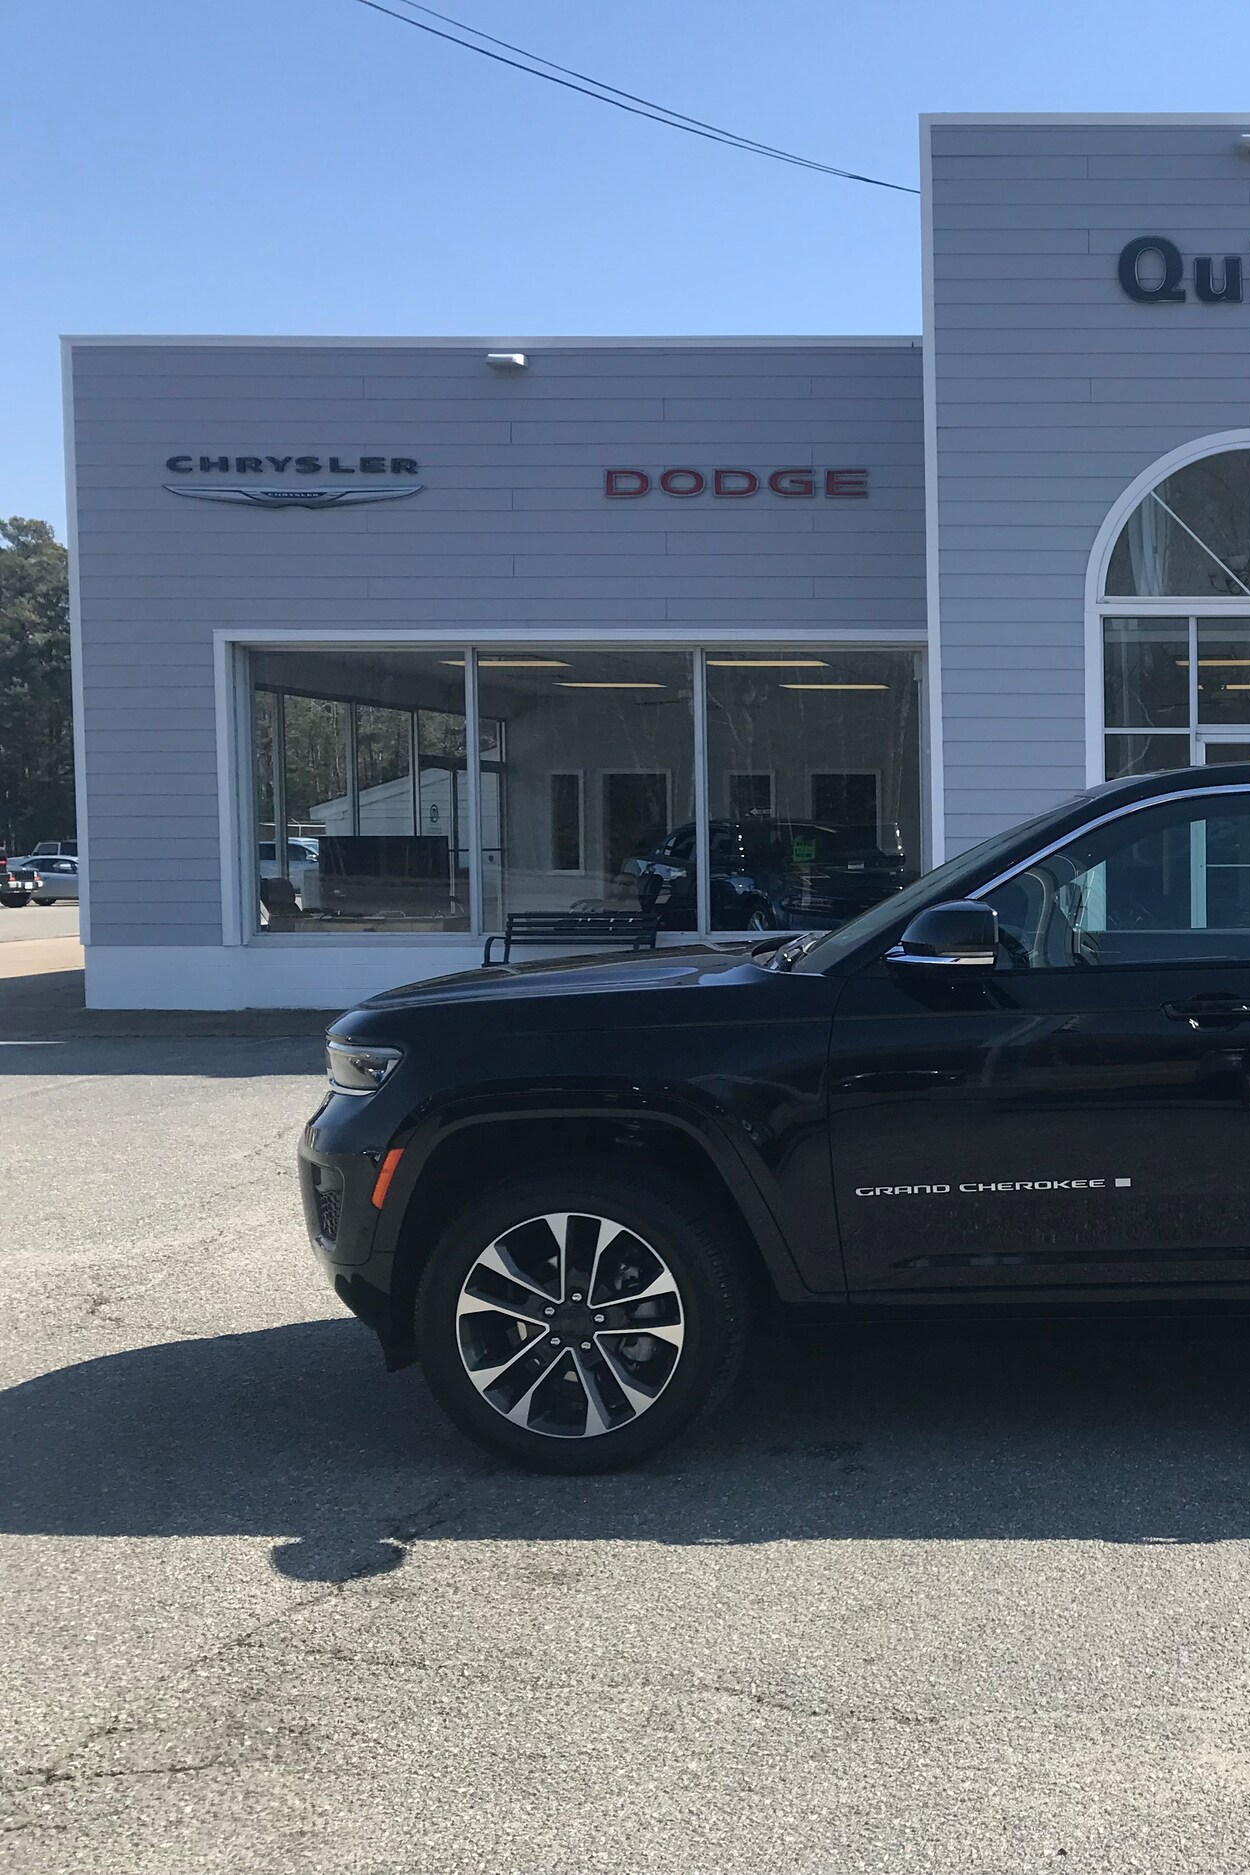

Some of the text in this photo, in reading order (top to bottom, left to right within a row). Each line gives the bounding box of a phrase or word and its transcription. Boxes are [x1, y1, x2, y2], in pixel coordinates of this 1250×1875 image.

[166, 455, 418, 474] CHRYSLER
[604, 468, 869, 498] DODGE
[855, 1178, 1105, 1196] GRAND CHEROKEE
